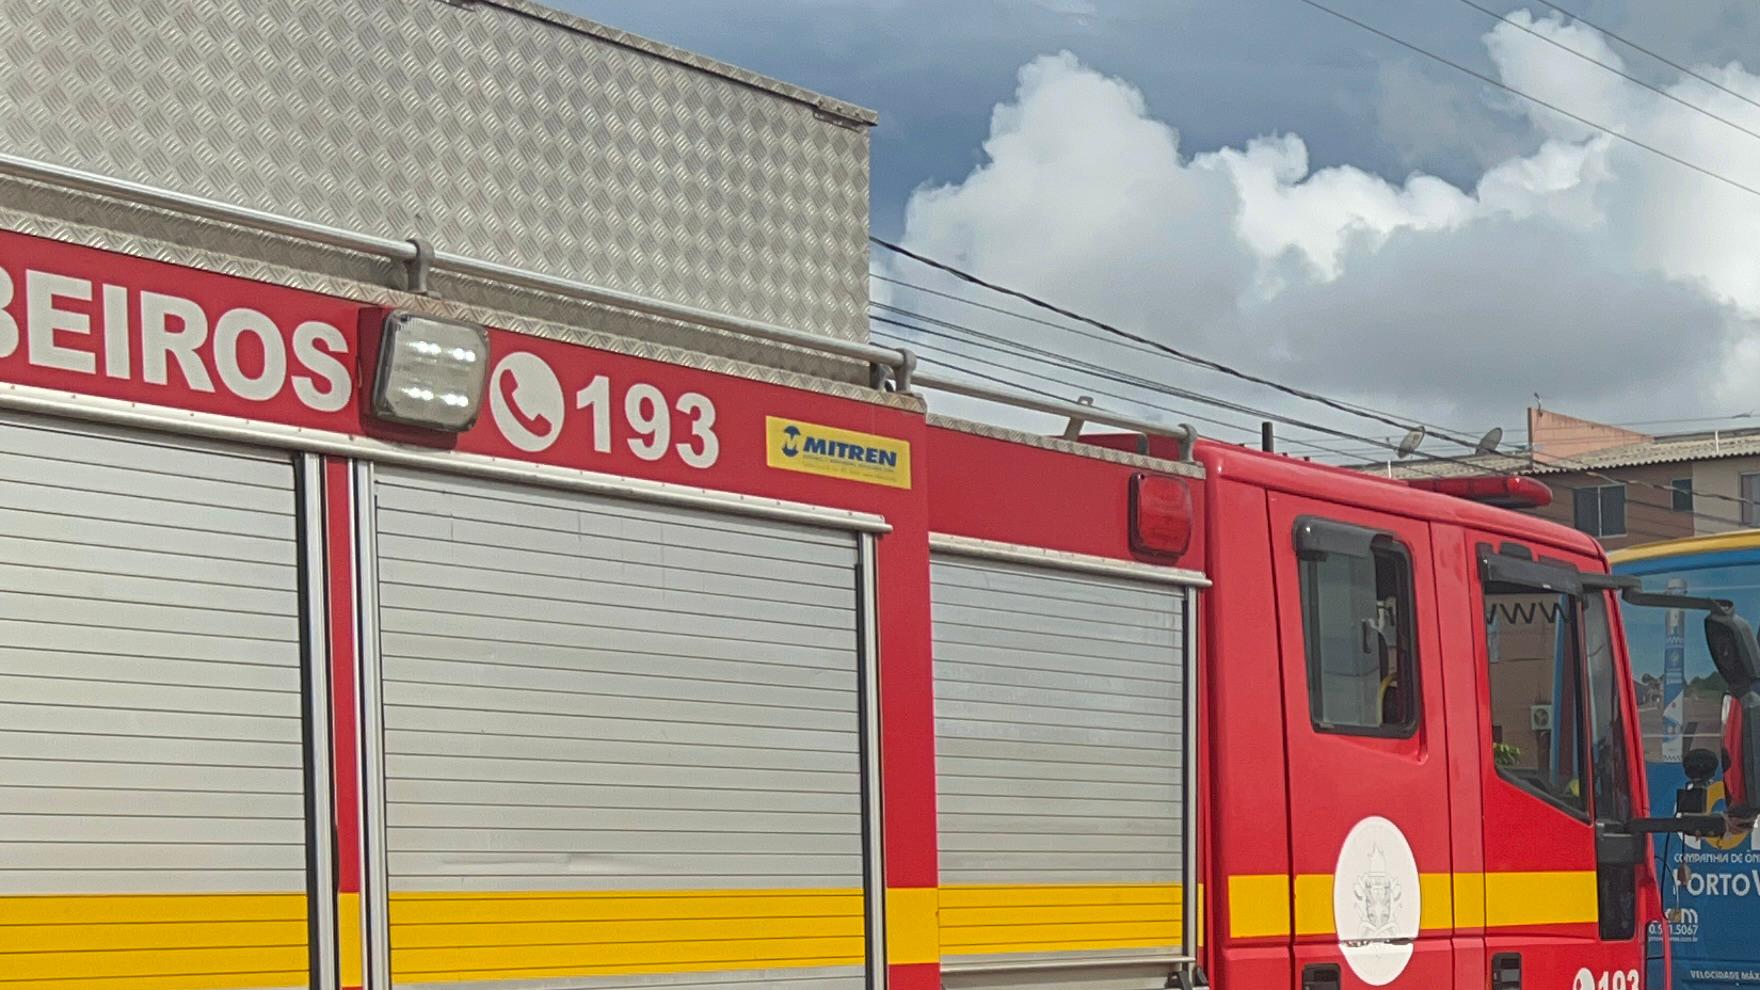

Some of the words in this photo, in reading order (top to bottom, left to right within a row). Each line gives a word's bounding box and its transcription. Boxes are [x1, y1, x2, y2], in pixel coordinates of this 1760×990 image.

[0, 265, 352, 413] EIROS
[576, 374, 720, 469] 193
[803, 436, 897, 467] MITREN
[1730, 853, 1743, 864] DE
[1690, 969, 1740, 981] VELOCIDADE
